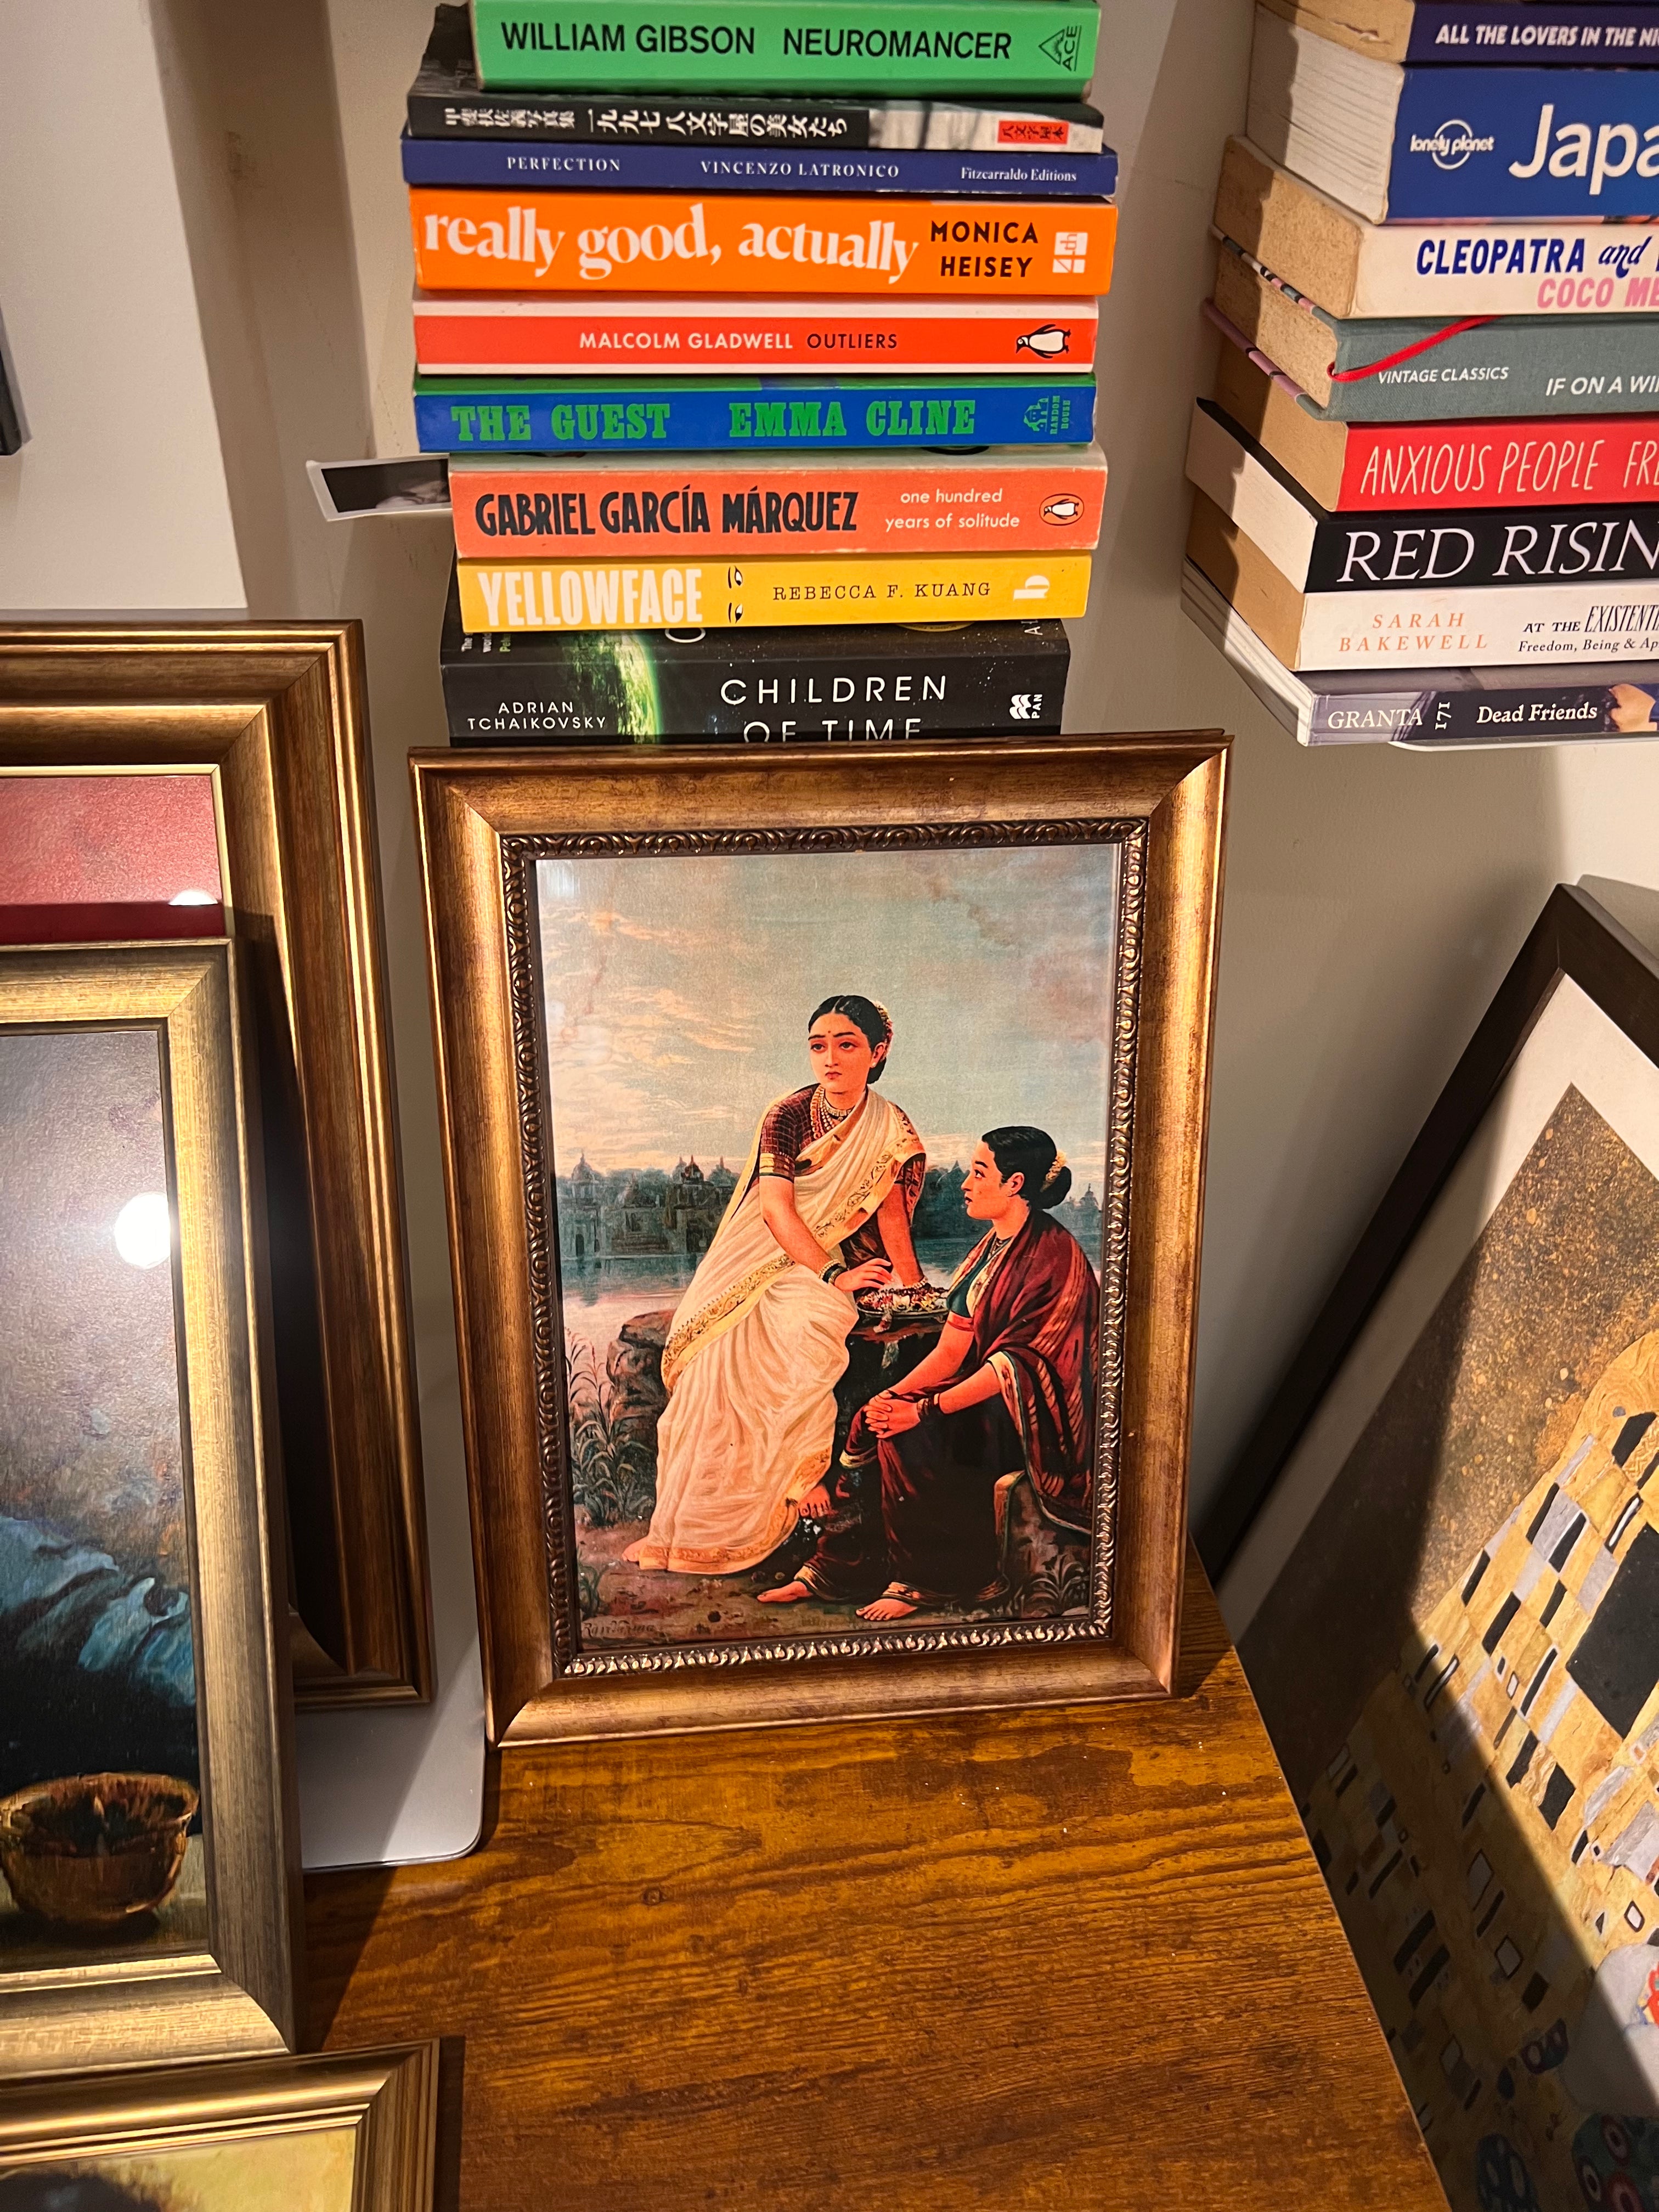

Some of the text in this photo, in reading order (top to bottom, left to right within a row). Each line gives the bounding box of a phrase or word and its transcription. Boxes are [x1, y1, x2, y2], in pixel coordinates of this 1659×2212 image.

[501, 22, 755, 54] WILLIAM GIBSON
[783, 28, 1012, 59] NEUROMANCER
[1435, 25, 1659, 47] ALL THE LOVERS IN THE NI
[1063, 26, 1075, 71] ACE
[588, 109, 660, 135] 一九九七
[666, 111, 847, 137] 八文字屋の美女たち
[1410, 134, 1494, 156] lonely planet
[507, 156, 900, 178] PERFECTION VINCENZO LATRONICO
[961, 167, 1076, 182] Fitzcarraldo Editions
[424, 202, 919, 285] really good, actually
[930, 221, 1038, 244] MONICA
[940, 256, 1032, 278] HEISEY
[1417, 238, 1585, 275] CLEOPATRA
[1598, 235, 1653, 279] and
[1537, 278, 1615, 308] COCO
[579, 332, 898, 350] MALCOLM GLADWELL OUTLIERS
[1379, 366, 1509, 384] VINTAGE CLASSICS
[1545, 378, 1565, 396] IF
[1571, 377, 1605, 395] ON
[1607, 376, 1622, 394] A
[451, 400, 975, 441] THE GUEST EMMA CLINE
[1049, 395, 1060, 435] RANDOM
[1061, 399, 1071, 430] HOUSE
[1361, 443, 1492, 496] ANXIOUS
[1498, 439, 1605, 494] PEOPLE
[900, 488, 1002, 504] one hundred
[475, 483, 859, 536] GABRIEL GARCÍA MÁRQUEZ
[885, 512, 1020, 532] years of solitude
[1337, 528, 1474, 582] RED
[478, 568, 991, 627] YELLOWFACE REBECCA F. KUANG
[1372, 612, 1465, 629] SARAH
[1523, 622, 1544, 633] AT
[1552, 620, 1580, 632] THE
[1339, 634, 1488, 652] BAKEWELL
[1518, 637, 1659, 653] Freedom, Being & Ap
[721, 675, 946, 706] CHILDREN
[498, 702, 573, 714] ADRIAN
[1031, 693, 1042, 719] PAN
[1328, 702, 1597, 730] GRANTA 171 Dead Friends
[467, 717, 606, 731] TCHAIKOVSKY
[743, 721, 796, 743] OF
